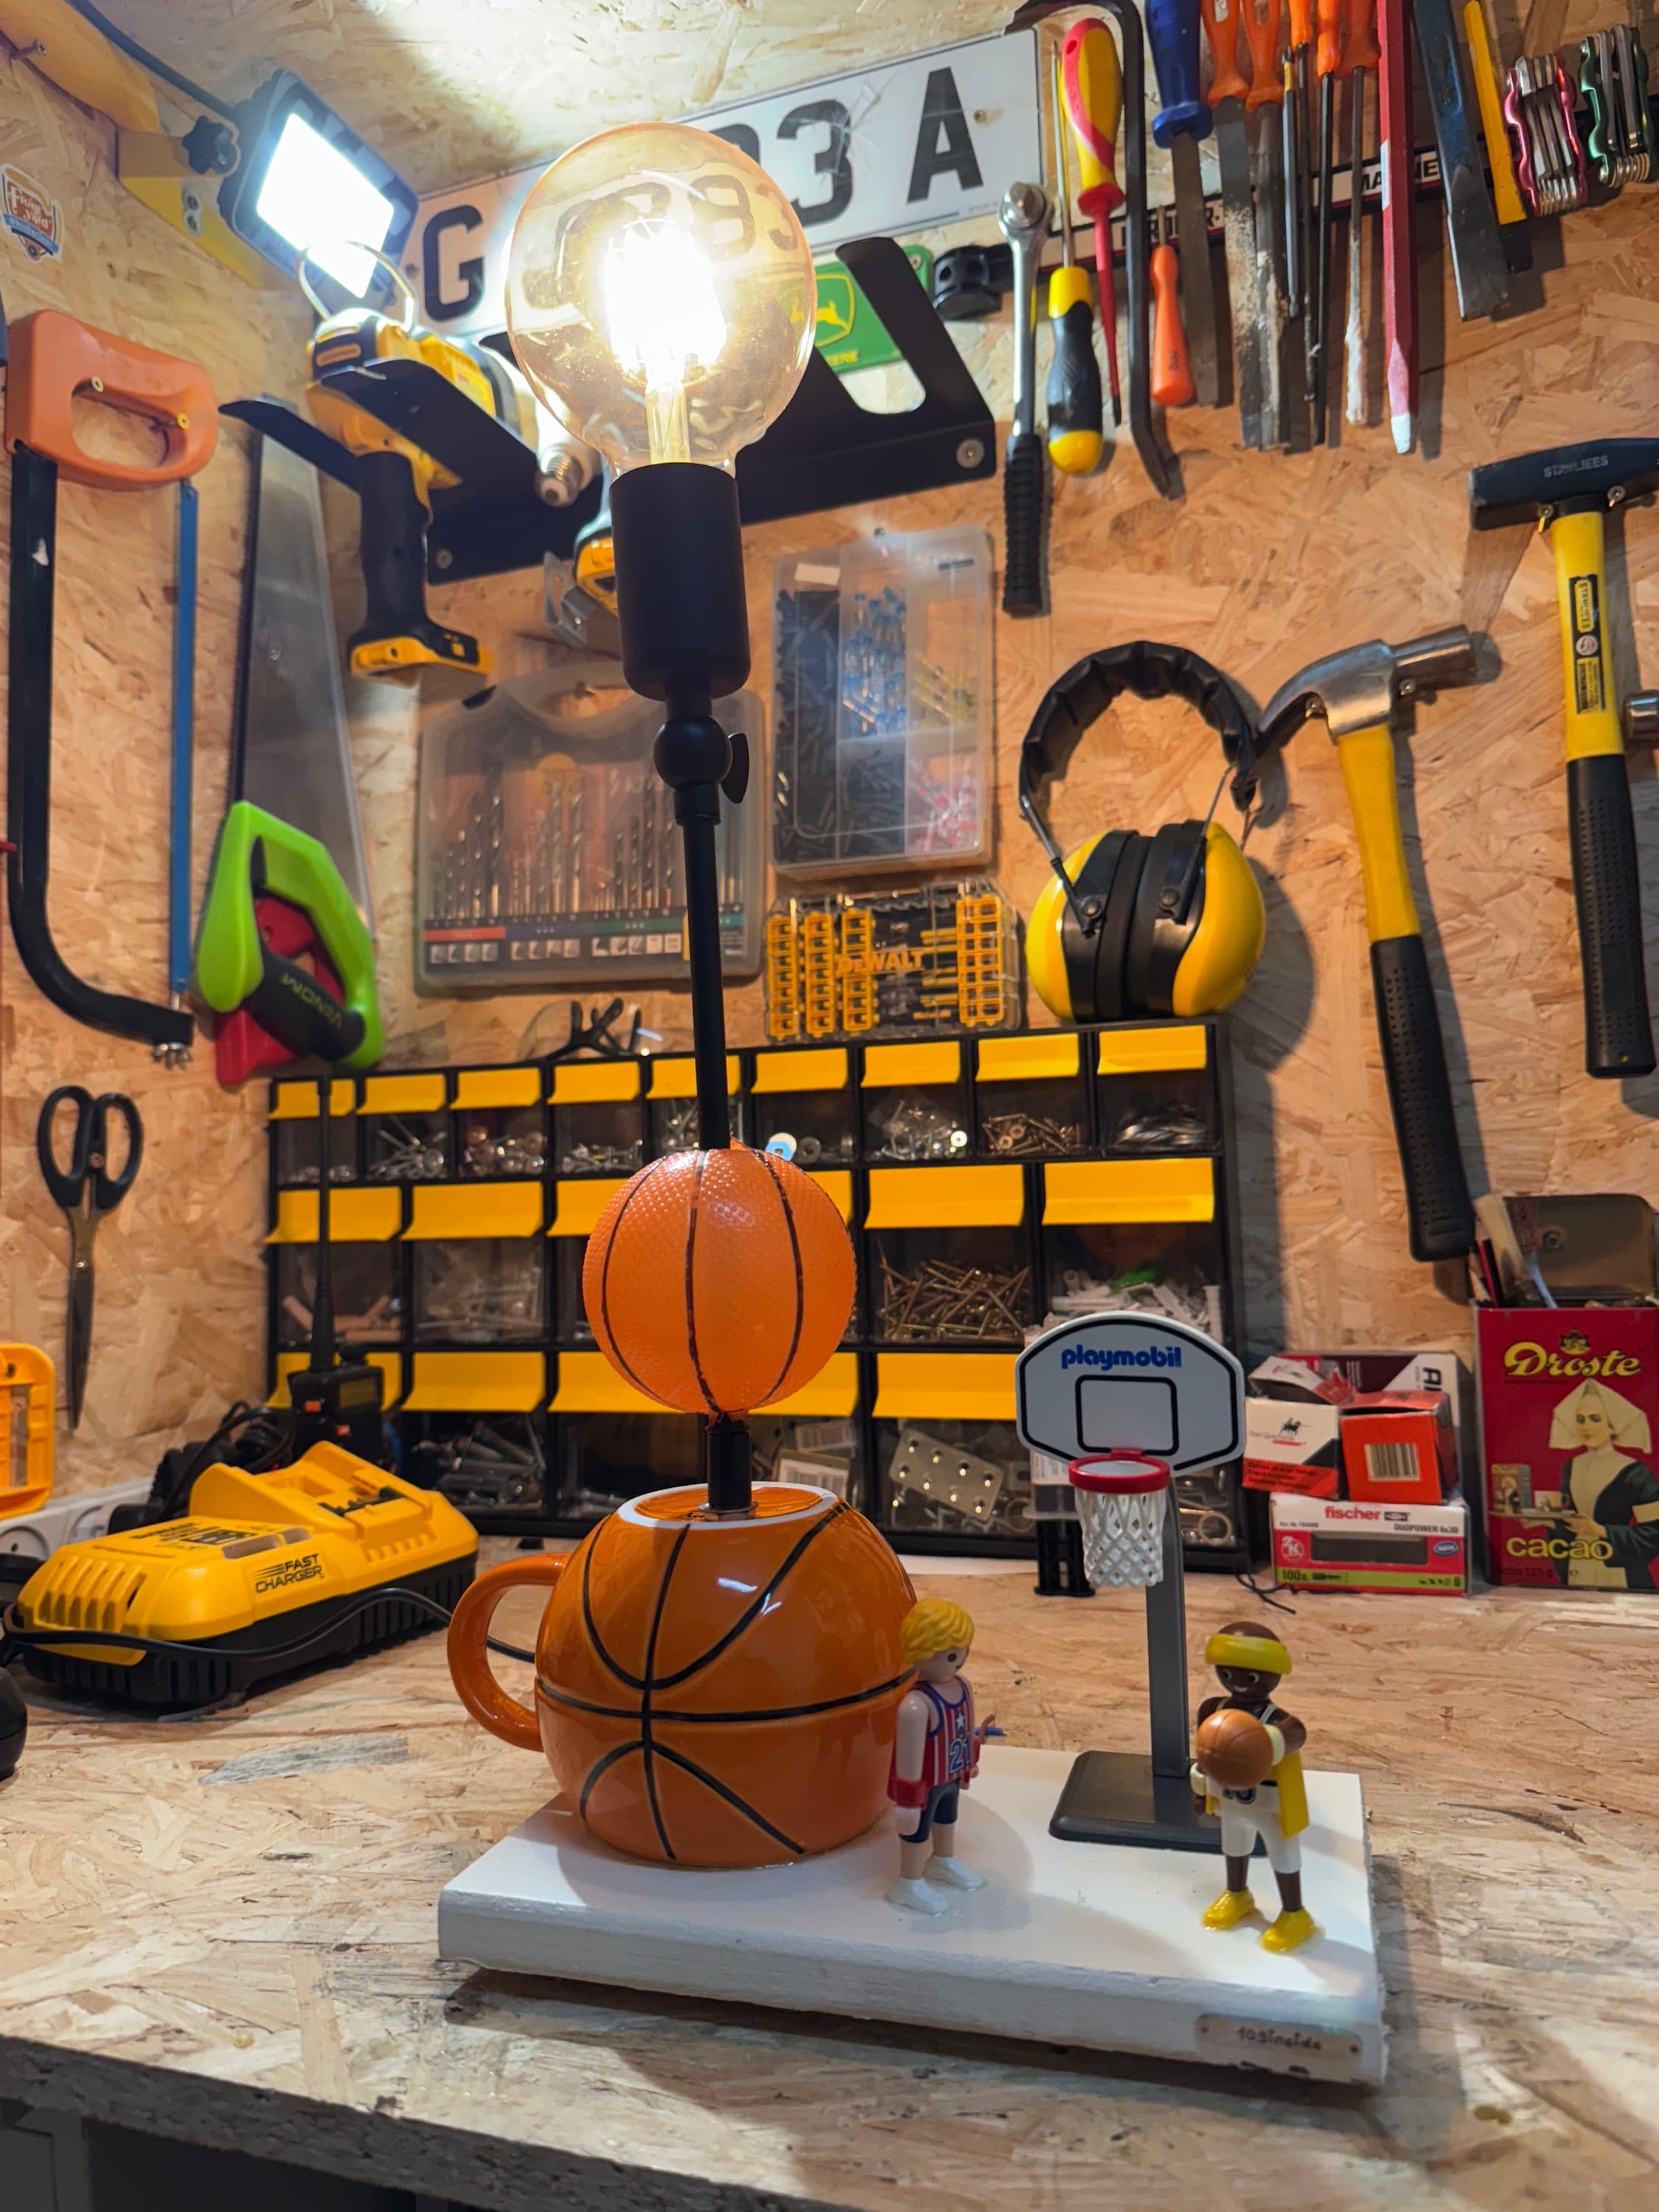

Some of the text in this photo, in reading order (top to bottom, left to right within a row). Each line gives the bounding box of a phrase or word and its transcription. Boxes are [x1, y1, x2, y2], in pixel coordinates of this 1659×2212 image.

[906, 66, 984, 204] A
[282, 973, 341, 1029] VENOM
[1060, 1344, 1182, 1371] playmobil
[1503, 1340, 1643, 1377] Droste
[1324, 1506, 1382, 1520] fischer
[1506, 1537, 1613, 1561] cacao
[285, 1554, 319, 1573] FAST
[1282, 1569, 1308, 1582] 100x
[254, 1565, 322, 1594] CHARGER
[949, 1731, 971, 1773] 21
